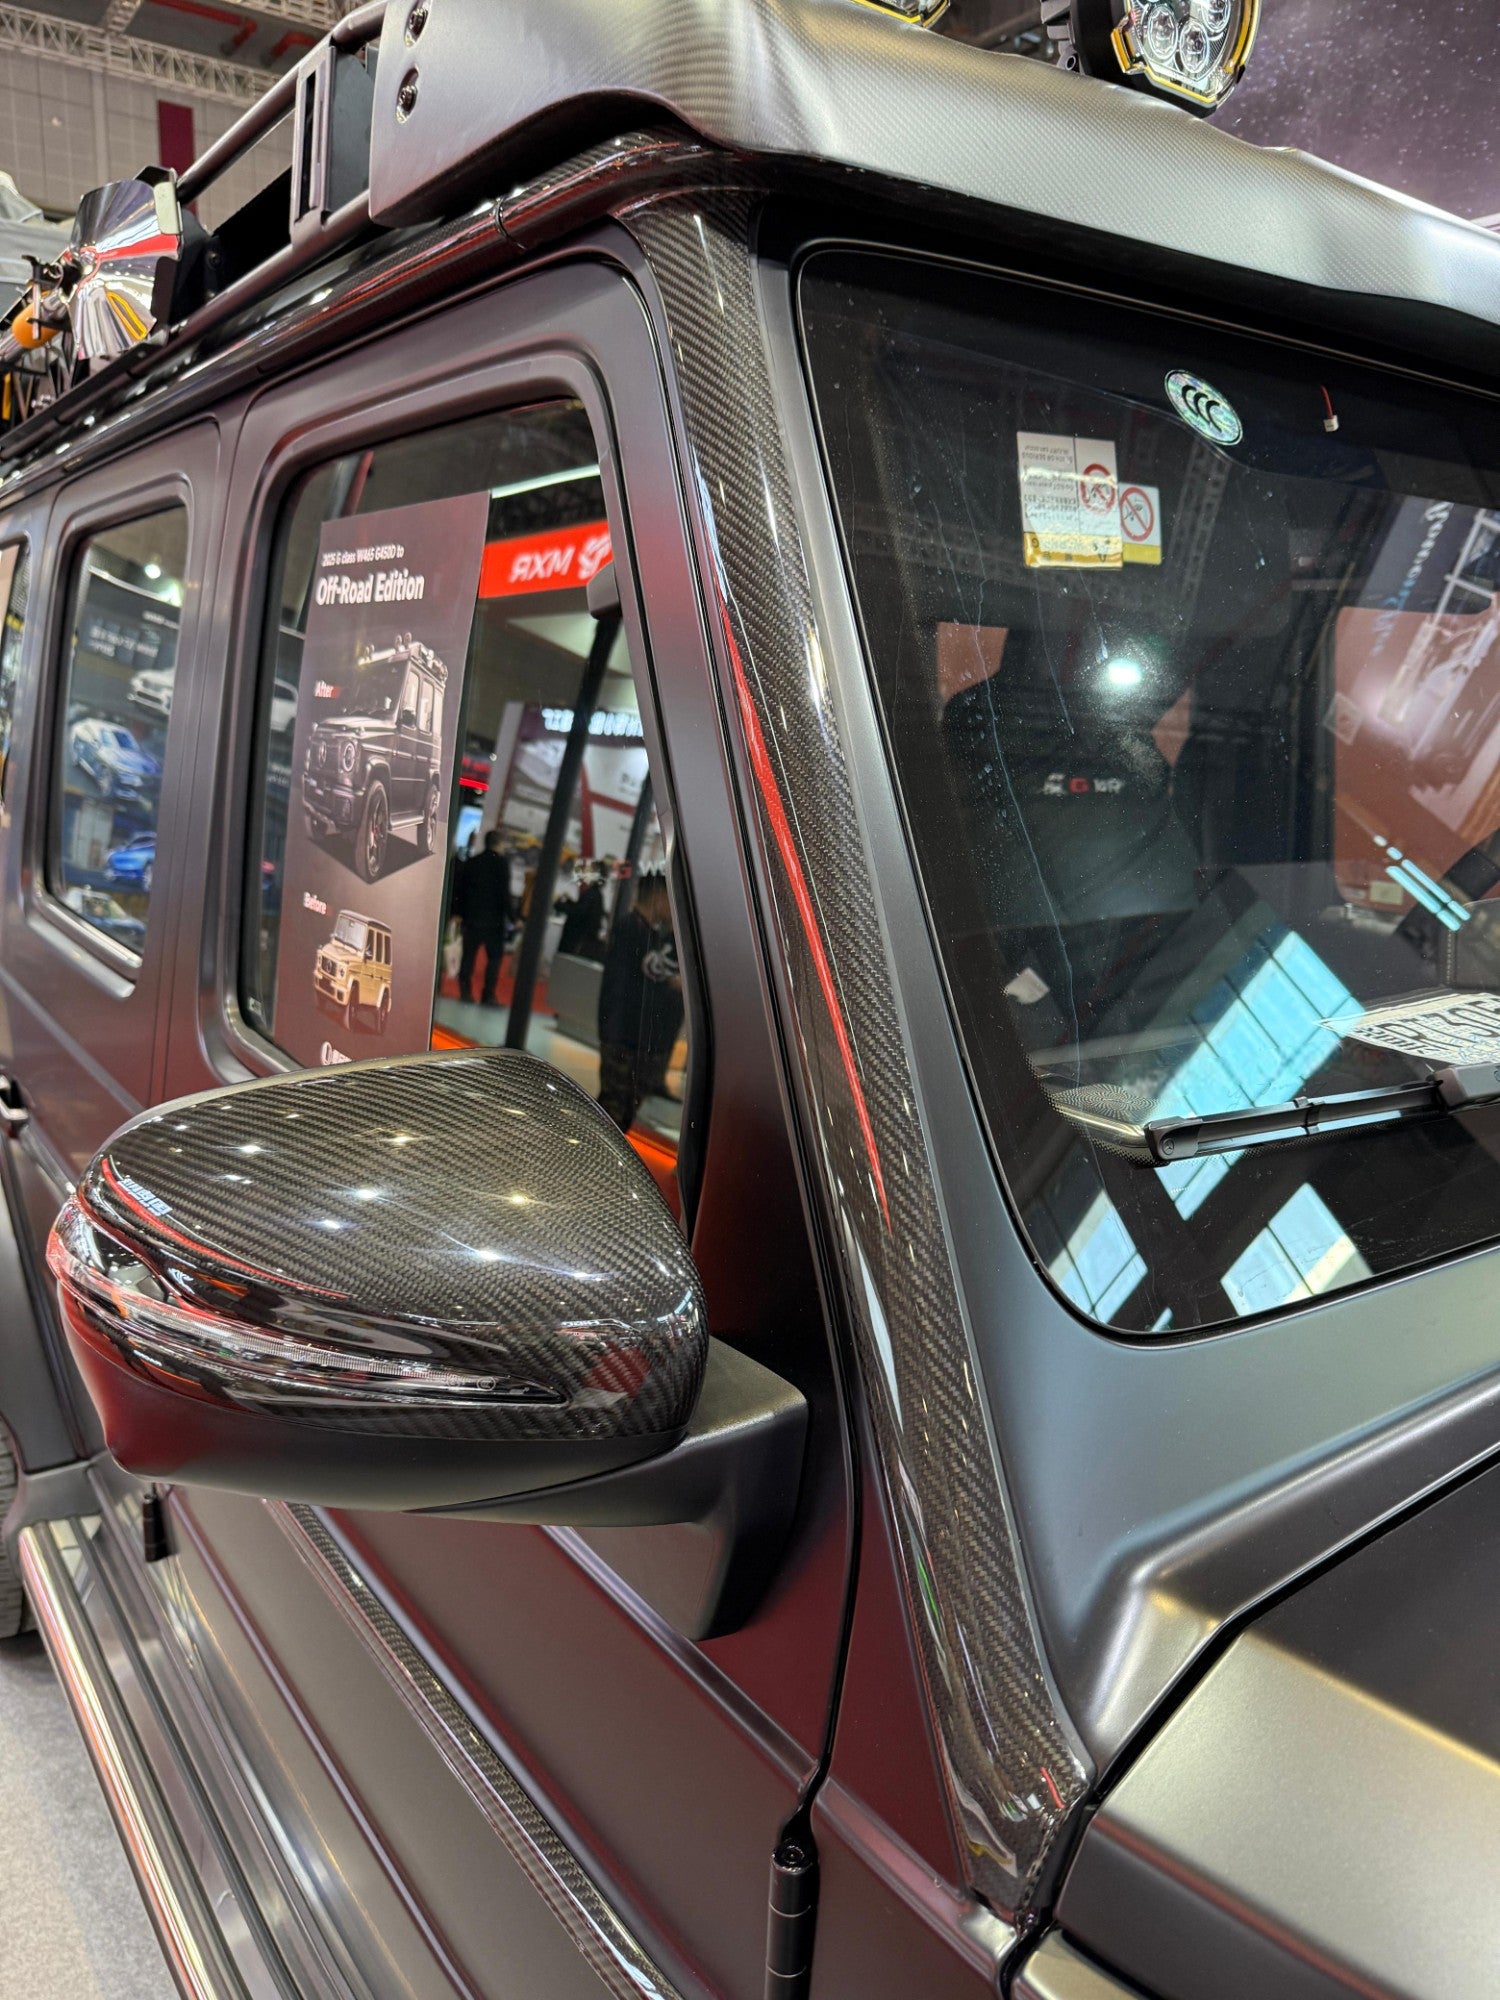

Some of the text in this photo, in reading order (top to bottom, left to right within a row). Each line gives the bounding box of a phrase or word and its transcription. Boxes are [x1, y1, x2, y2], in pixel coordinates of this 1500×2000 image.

[341, 551, 356, 565] class
[396, 544, 405, 559] to
[316, 568, 425, 606] Off-Road Edition
[314, 680, 334, 698] After
